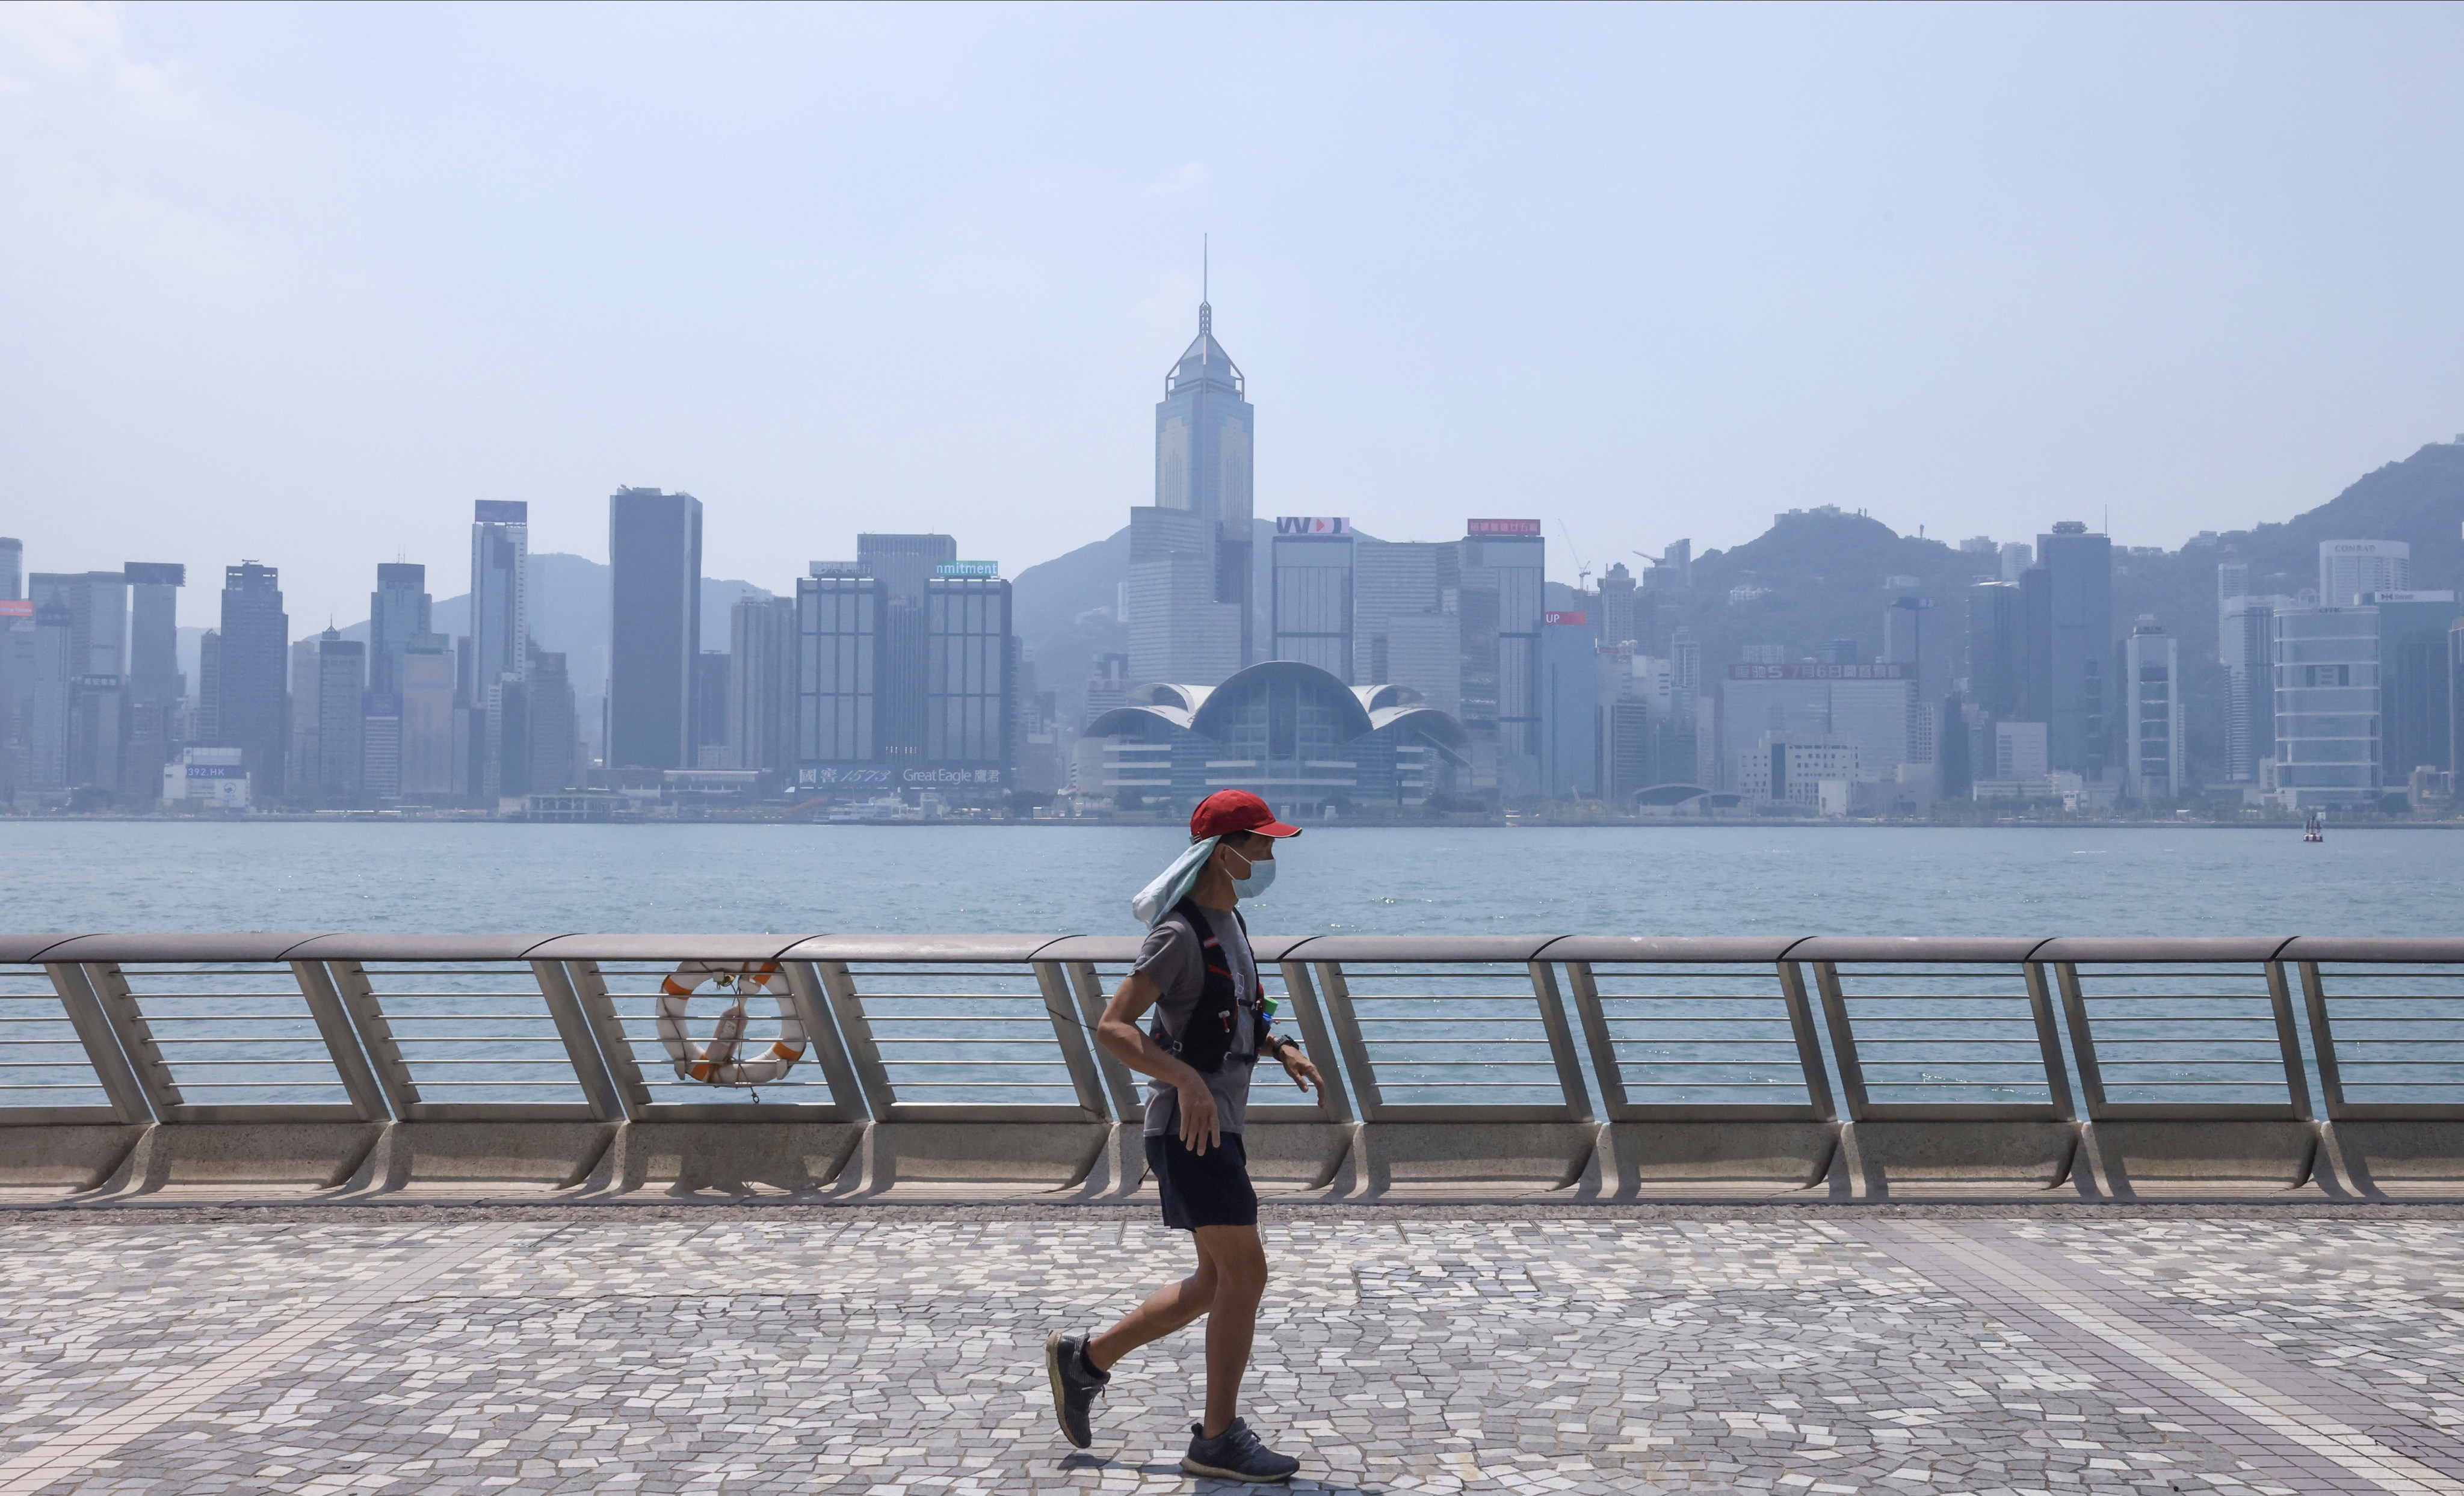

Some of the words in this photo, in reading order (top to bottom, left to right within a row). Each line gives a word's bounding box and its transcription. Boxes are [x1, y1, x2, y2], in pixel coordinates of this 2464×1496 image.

[1546, 614, 1560, 623] UP
[185, 768, 224, 776] 392.HK
[839, 769, 891, 783] 1573
[903, 768, 936, 781] Great
[938, 768, 972, 784] Eagle
[974, 769, 1000, 783] 鷹君
